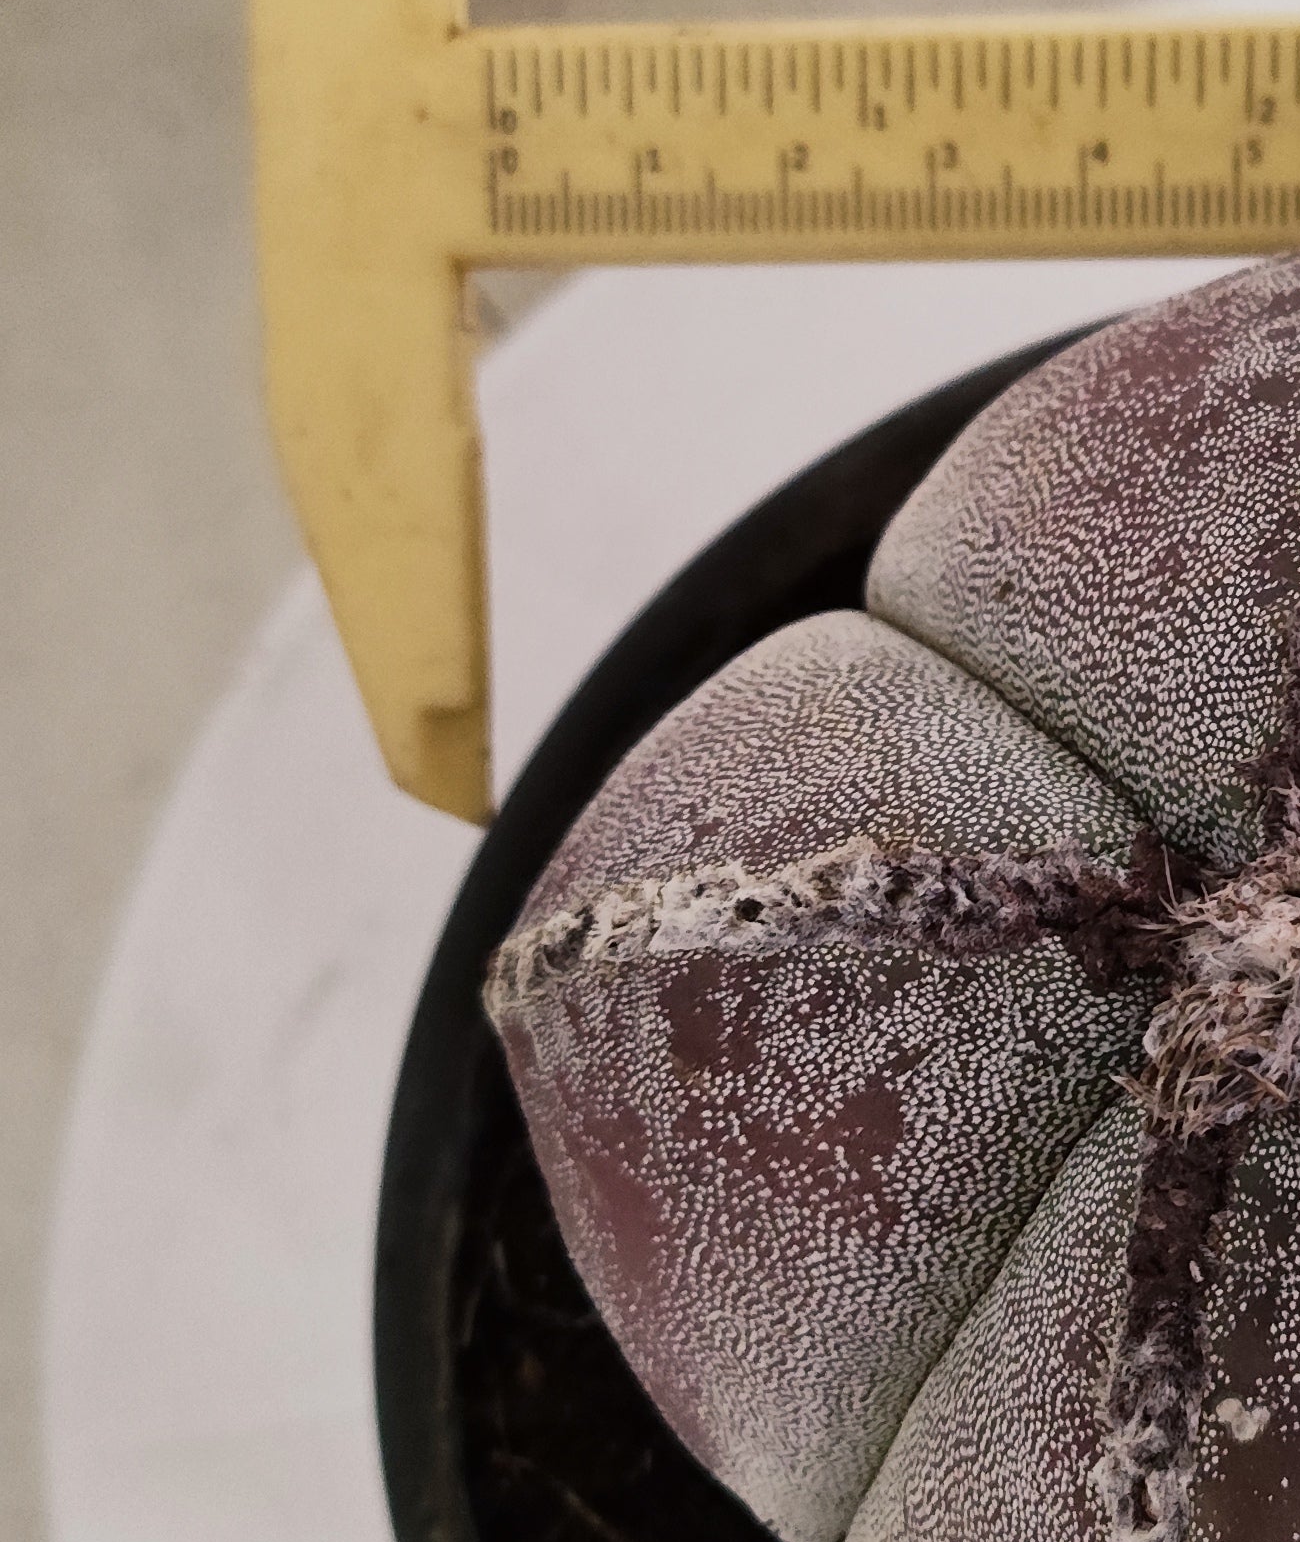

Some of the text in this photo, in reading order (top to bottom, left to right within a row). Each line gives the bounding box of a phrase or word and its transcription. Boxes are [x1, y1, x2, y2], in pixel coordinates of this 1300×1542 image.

[500, 107, 519, 135] 0
[1259, 95, 1277, 126] 2
[500, 145, 519, 175] 0
[645, 145, 662, 173] 1
[791, 141, 809, 172] 2
[941, 141, 959, 170] 3
[1090, 139, 1110, 165] 4
[1248, 136, 1264, 165] 5
